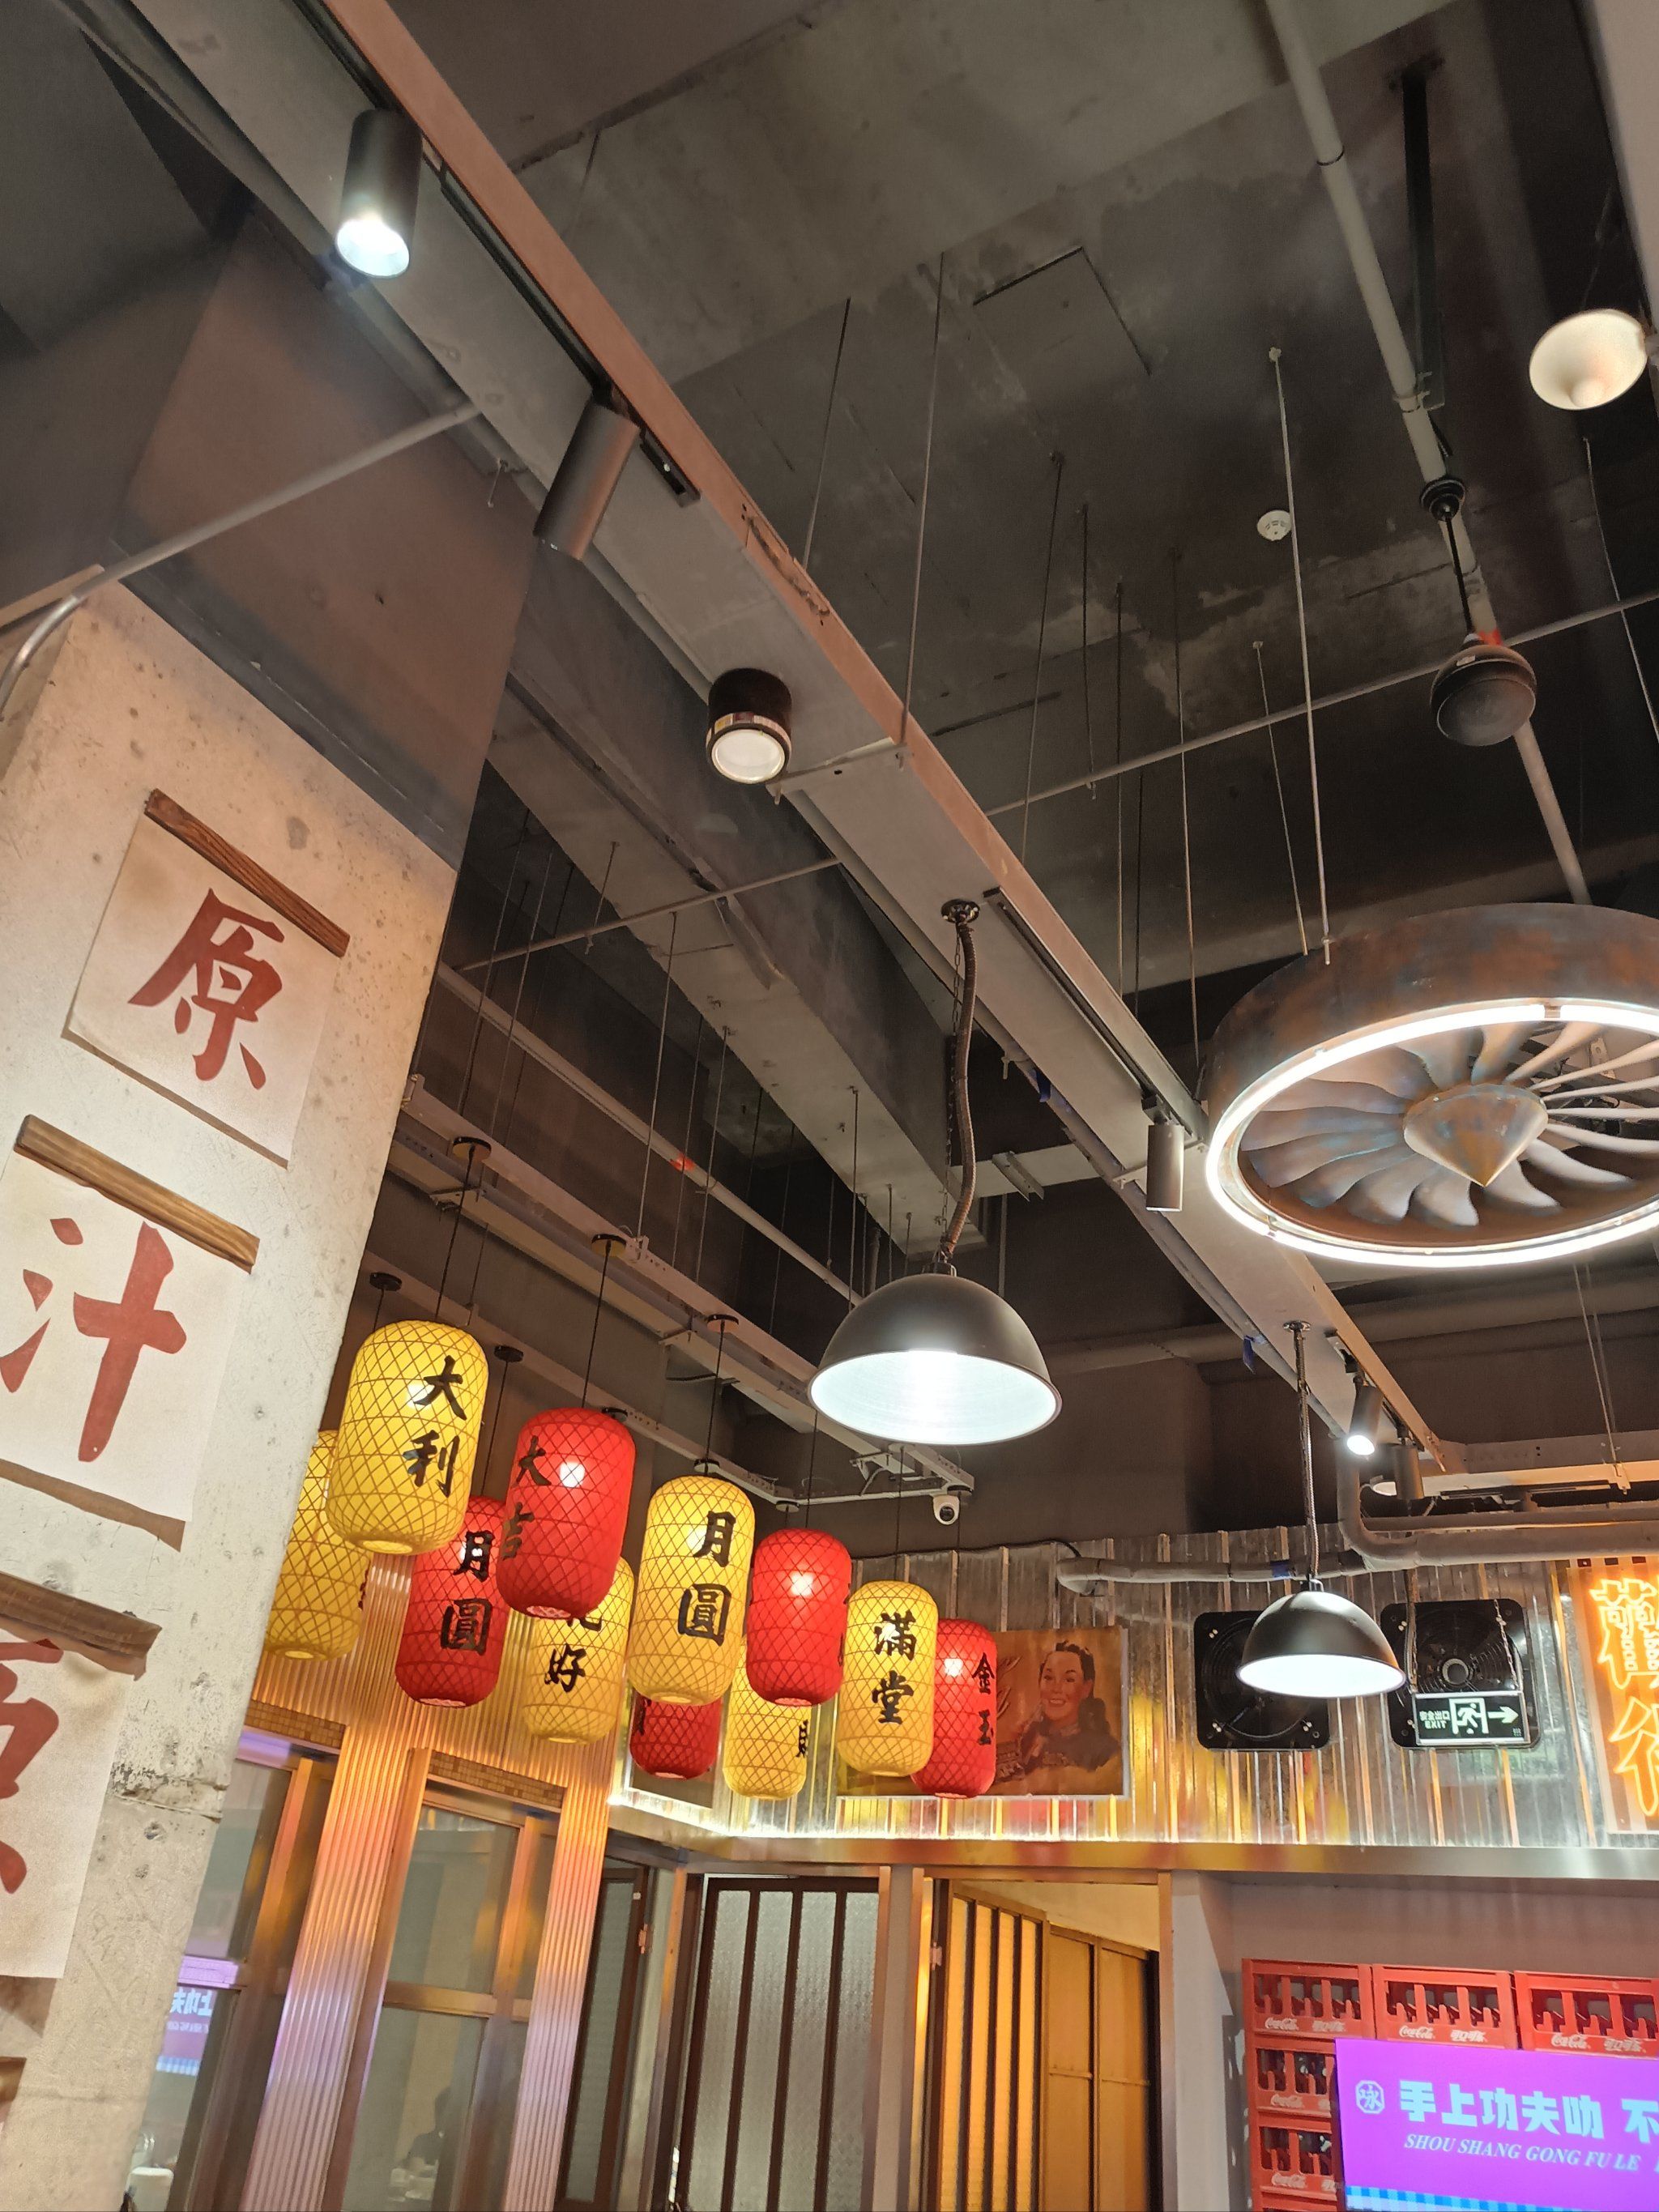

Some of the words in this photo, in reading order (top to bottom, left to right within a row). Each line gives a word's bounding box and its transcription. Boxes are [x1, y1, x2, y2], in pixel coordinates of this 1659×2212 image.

[129, 888, 285, 1090] 原
[0, 1217, 187, 1463] 汁
[403, 1355, 467, 1497] 大利
[501, 1435, 552, 1559] 大吉
[1425, 1720, 1447, 1729] EXIT
[1404, 2133, 1456, 2153] SHOU
[1457, 2139, 1522, 2159] SHANG
[1525, 2145, 1581, 2166] GONG
[1584, 2150, 1611, 2168] FU
[1614, 2154, 1641, 2172] LE
